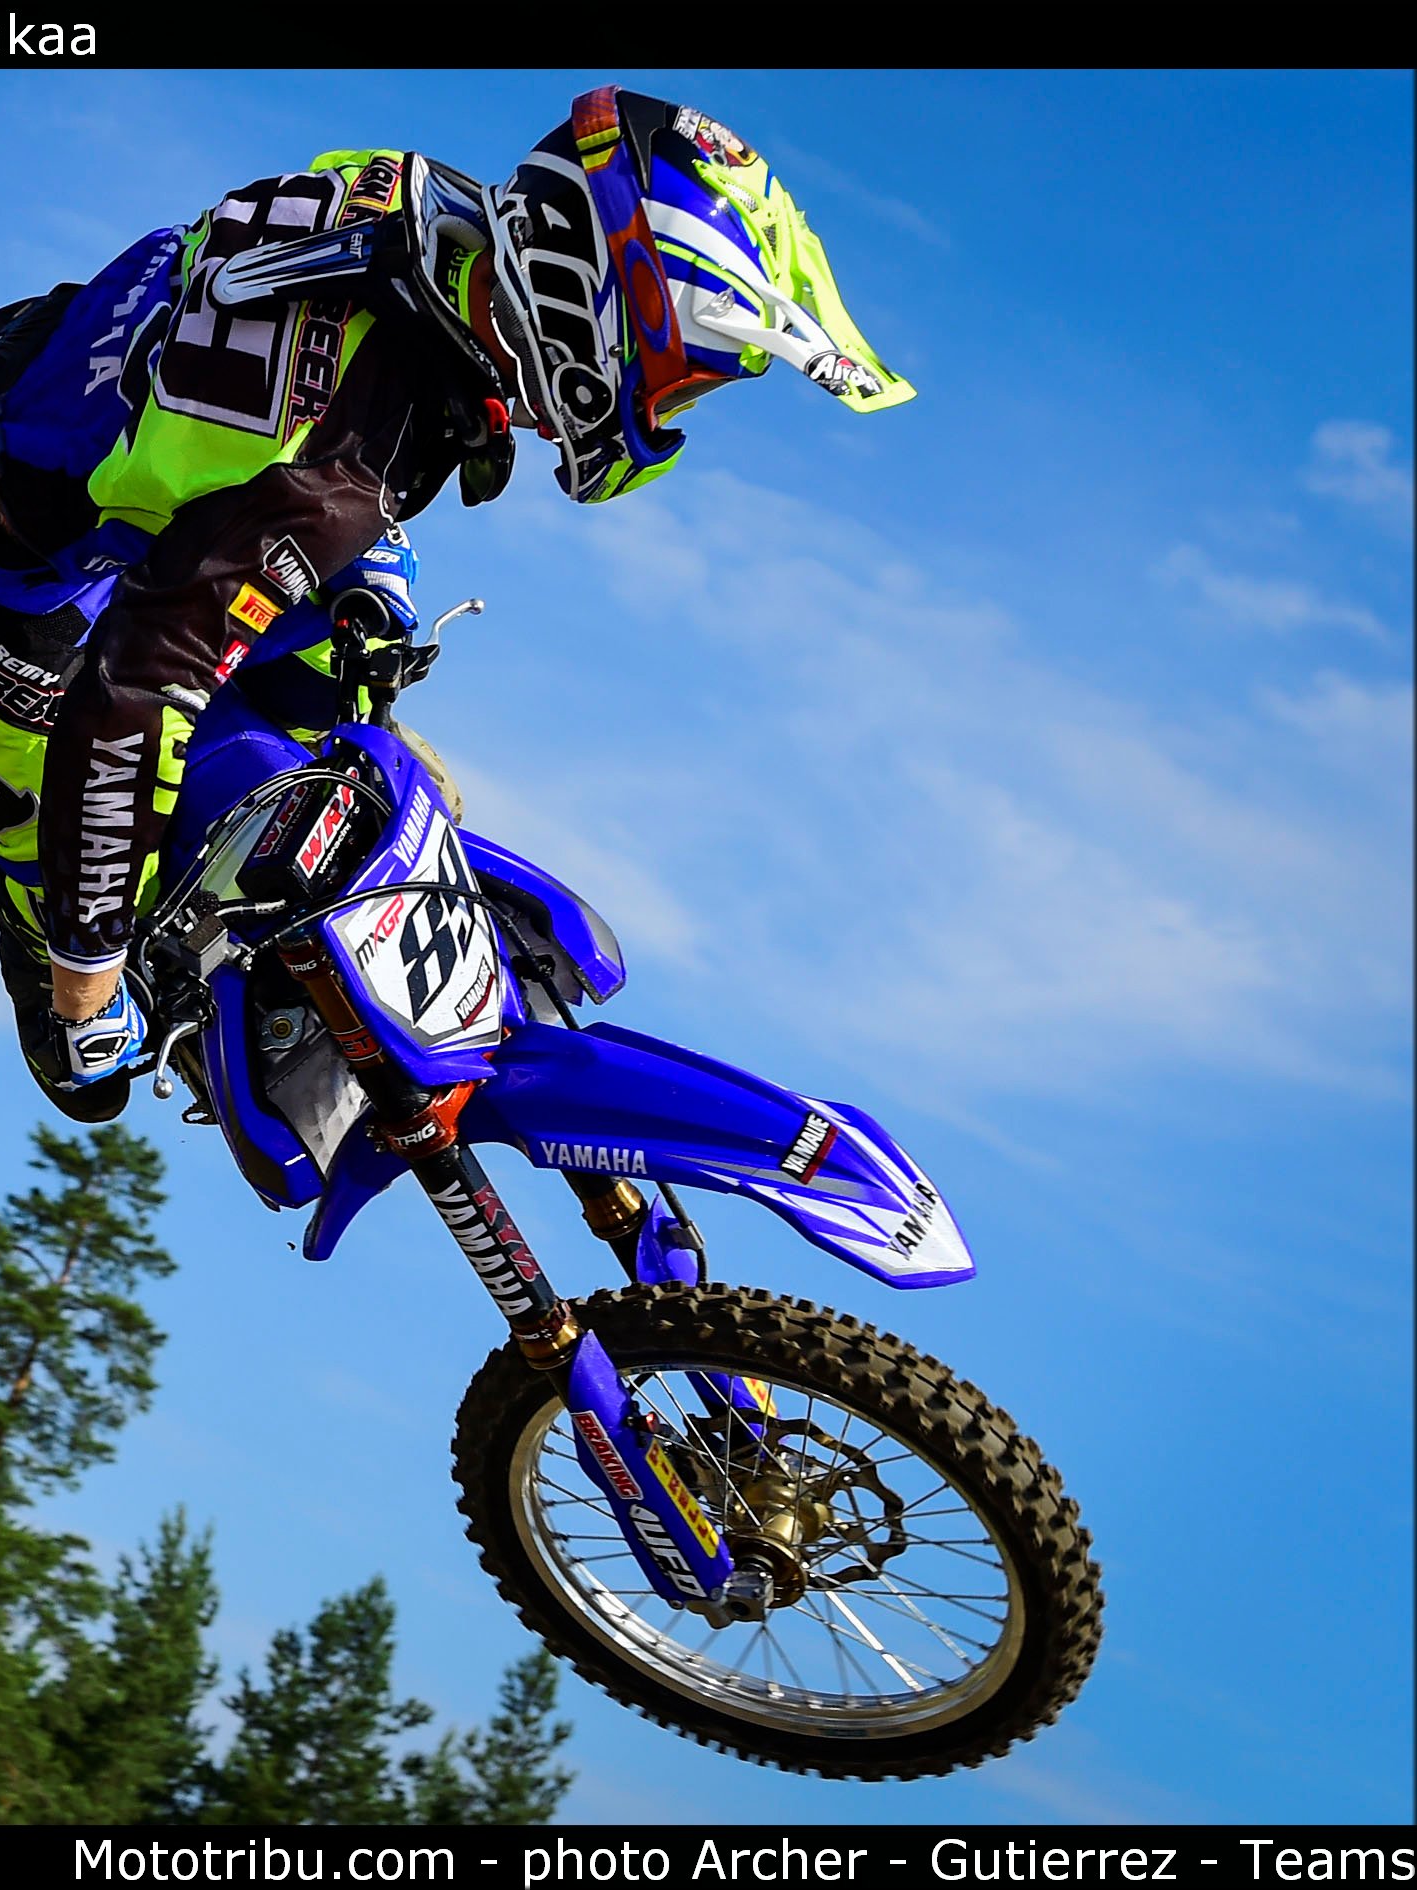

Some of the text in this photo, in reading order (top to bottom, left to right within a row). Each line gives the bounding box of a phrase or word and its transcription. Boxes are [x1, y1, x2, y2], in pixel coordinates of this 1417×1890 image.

[77, 731, 145, 924] YAMAHA
[392, 785, 432, 868] YAMAHA
[355, 892, 405, 972] MXGP
[540, 1141, 648, 1174] YAMAHA
[432, 1180, 533, 1316] YAMAHA
[888, 1182, 939, 1262] YAMAHA
[576, 1415, 639, 1497] BRAKING
